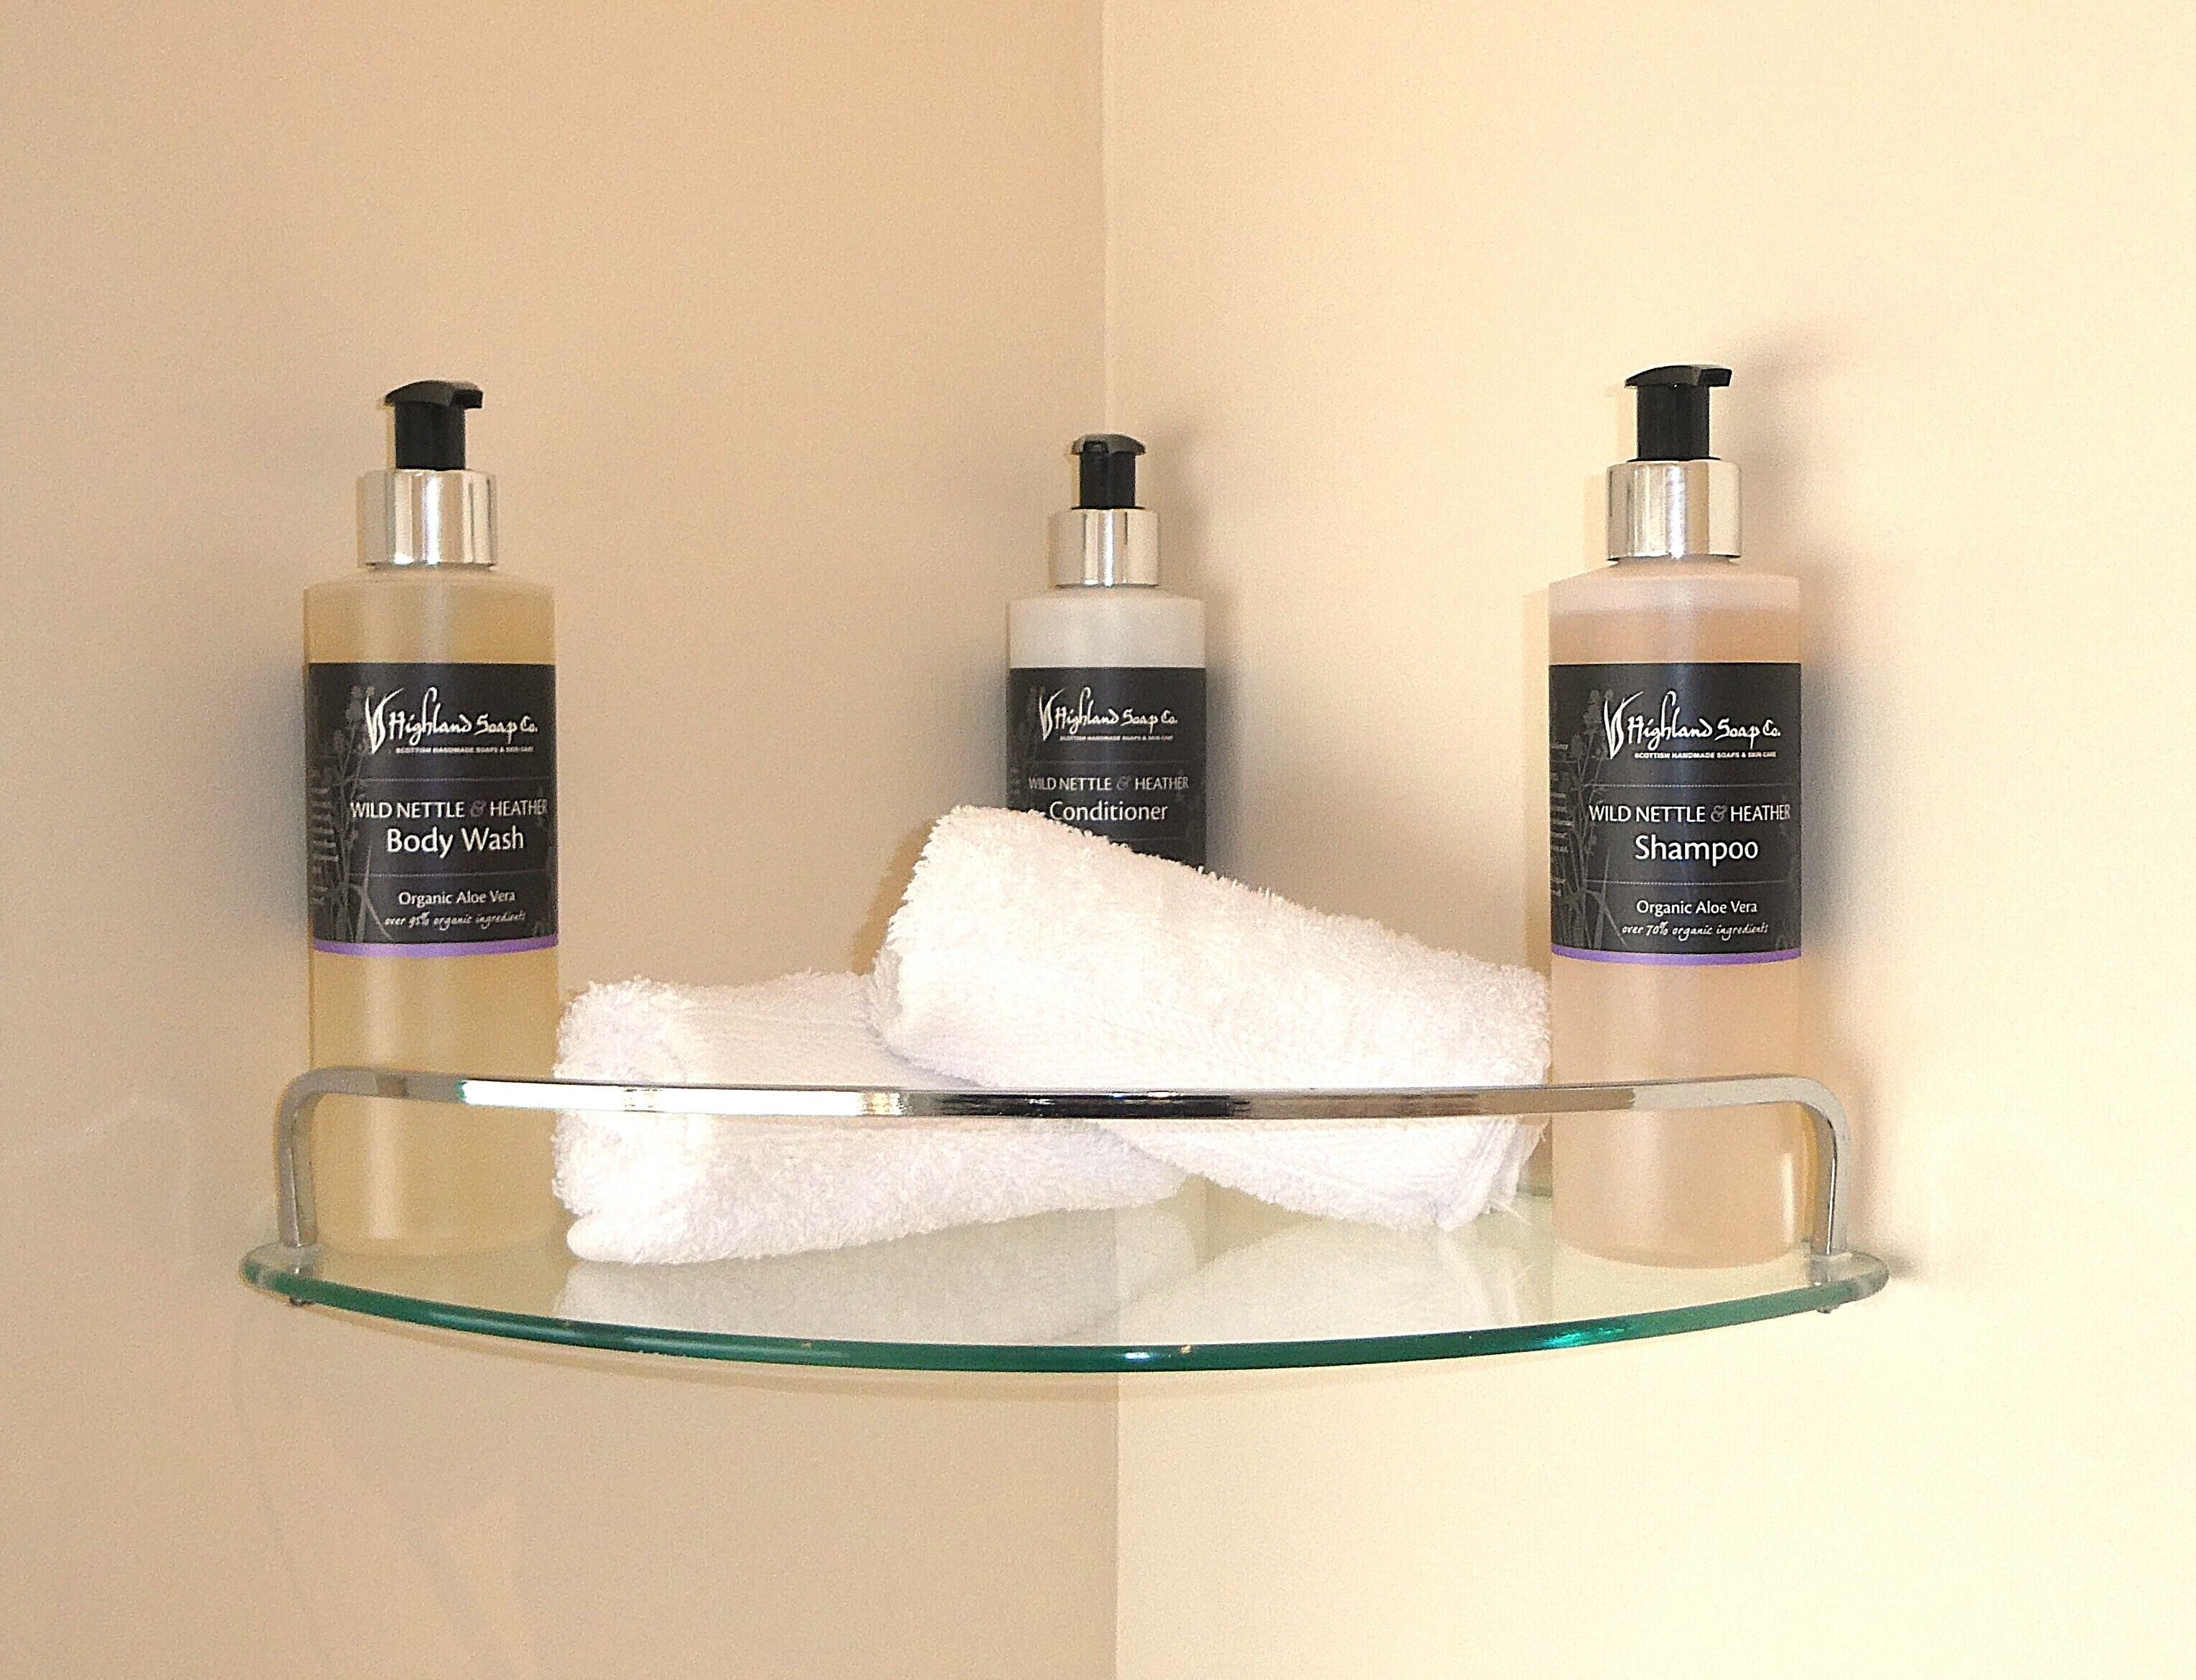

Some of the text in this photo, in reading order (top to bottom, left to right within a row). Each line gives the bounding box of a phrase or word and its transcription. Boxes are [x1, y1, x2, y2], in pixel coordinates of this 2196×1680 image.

[388, 686, 472, 747] Highland
[474, 713, 518, 744] Soap
[1055, 686, 1119, 734] Highland
[1120, 707, 1159, 734] Soap
[1627, 691, 1781, 751] Highland Soap Co.
[1028, 776, 1057, 791] WILD
[1059, 777, 1112, 791] NETTLE
[1134, 775, 1190, 791] HEATHER
[350, 801, 393, 819] WILD
[396, 801, 465, 818] NETTLE
[490, 798, 548, 818] HEATHER
[1049, 800, 1169, 821] Conditioner
[1589, 803, 1791, 823] WILD NETTLE & HEATHER
[386, 824, 524, 859] Body Wash
[1634, 834, 1759, 867] Shampoo
[398, 889, 516, 909] Organic Aloe Vera
[1635, 899, 1759, 918] Organic Aloe Vera
[385, 916, 406, 926] over
[433, 913, 473, 931] organic
[475, 909, 527, 930] ingredients
[1621, 920, 1770, 942] over 70% organic ingredients
